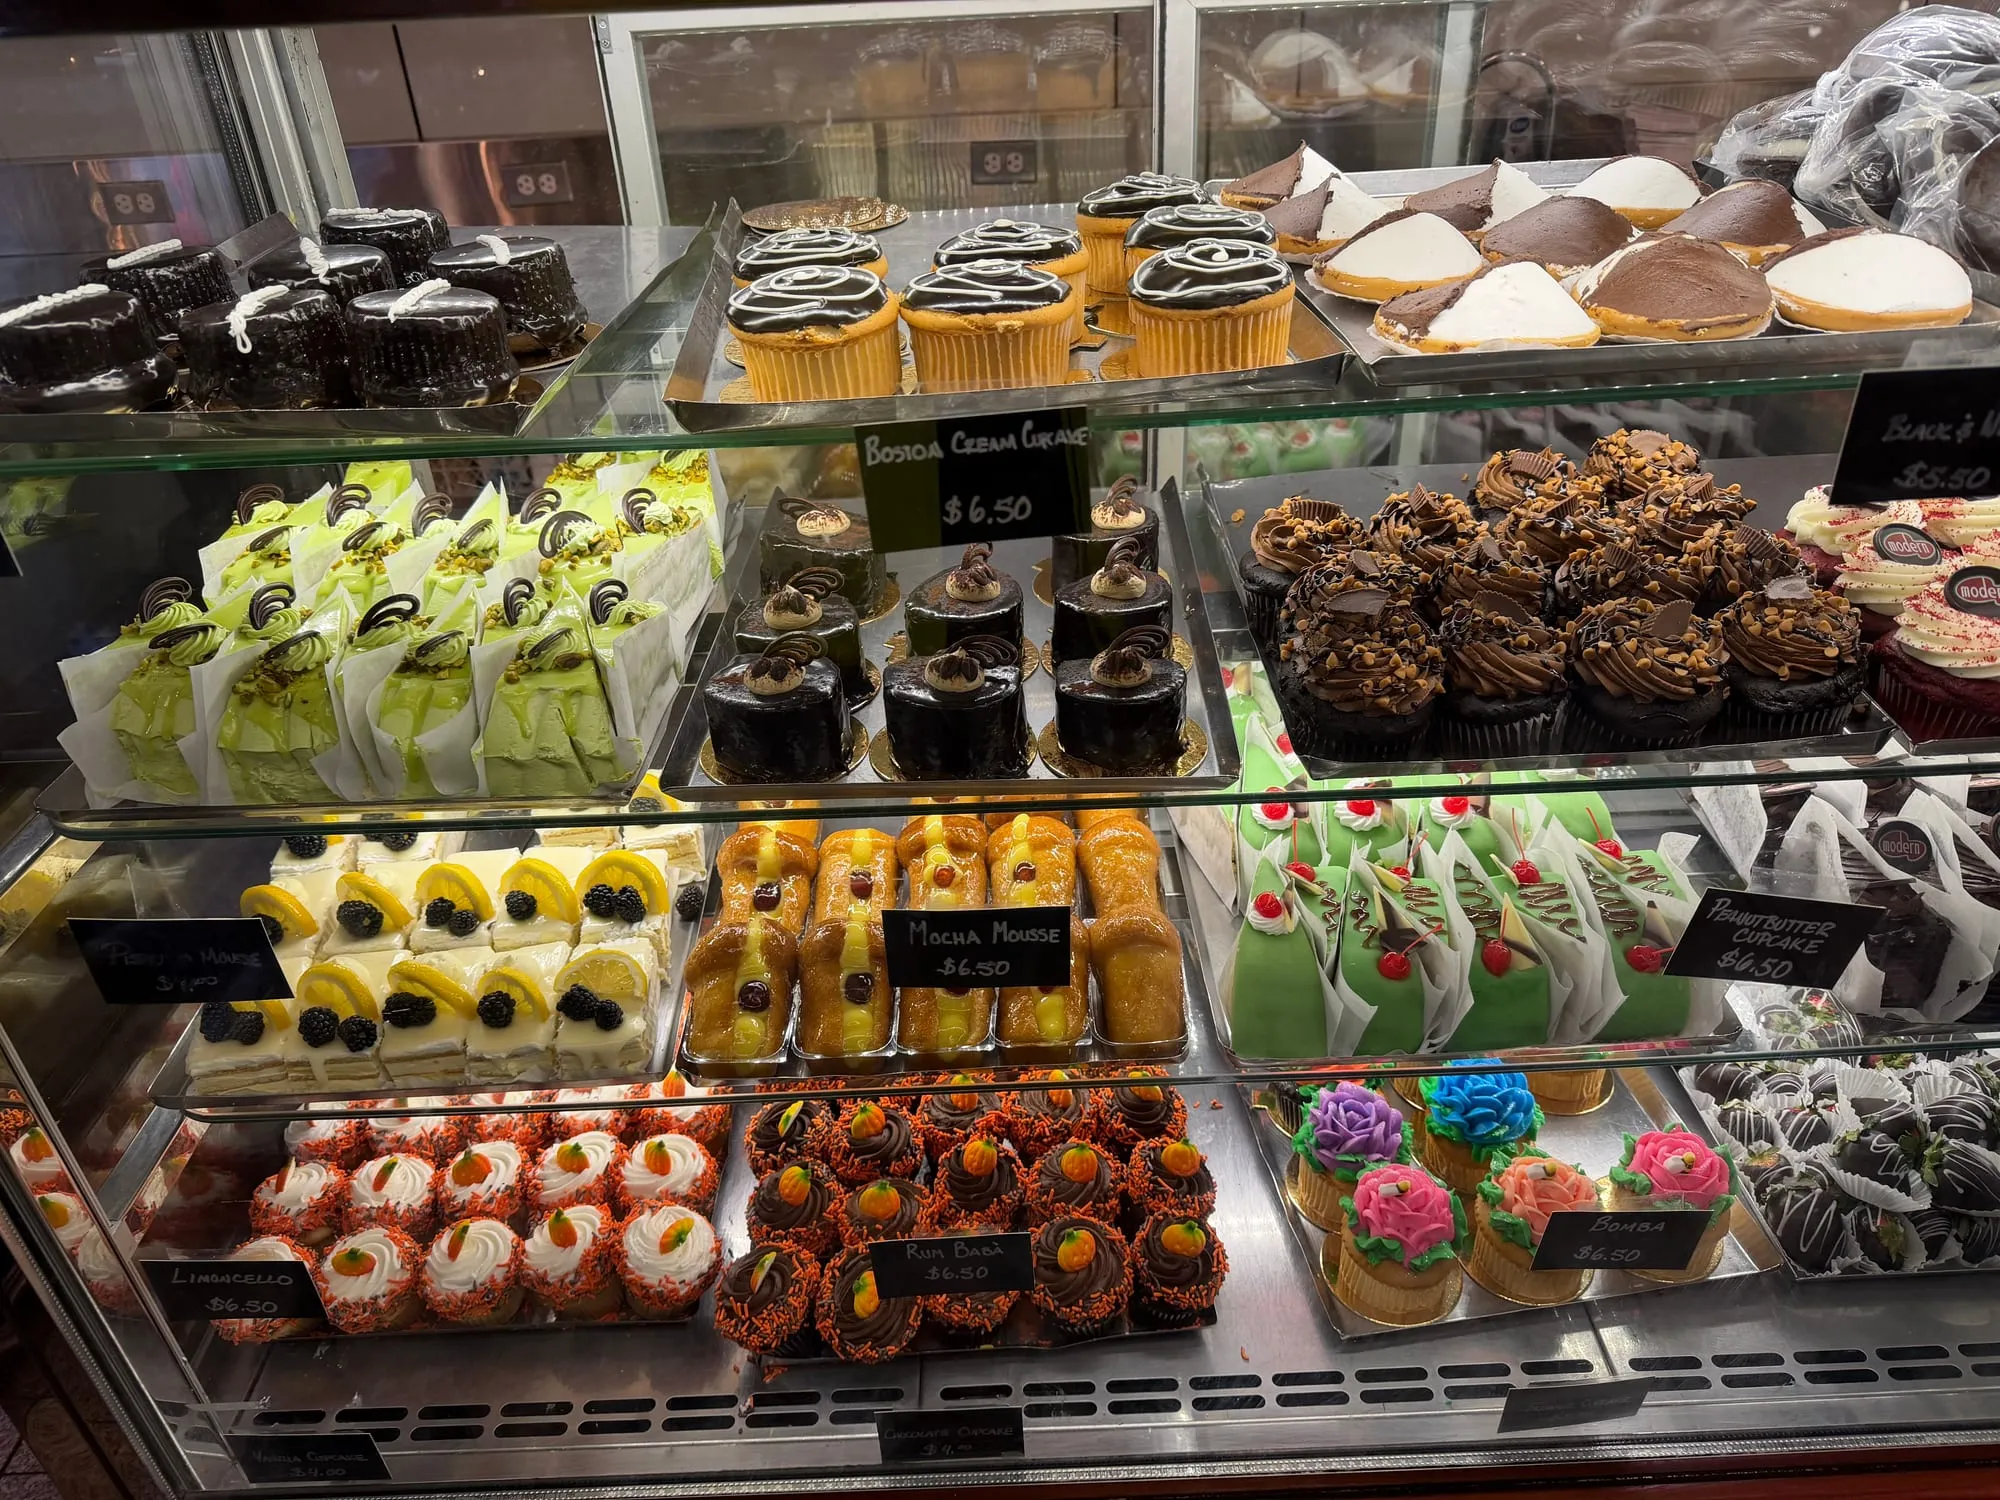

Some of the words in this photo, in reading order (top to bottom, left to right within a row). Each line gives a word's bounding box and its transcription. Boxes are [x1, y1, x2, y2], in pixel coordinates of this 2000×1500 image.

[1881, 413, 1953, 443] BLACK
[863, 434, 944, 467] BOSTON
[951, 430, 1017, 455] CREAM
[1893, 460, 1991, 490] $5.50
[1887, 532, 1930, 554] modern
[1882, 830, 1921, 856] modern
[909, 919, 982, 947] MOCHA
[992, 920, 1061, 945] MOUSSE
[1732, 927, 1825, 955] CUPCAKE
[936, 957, 1011, 977] $6.50
[1717, 947, 1794, 980] $6.50
[1589, 1215, 1666, 1233] BOMBA
[906, 1243, 945, 1260] RUM
[1573, 1245, 1641, 1262] $6.50
[170, 1267, 295, 1286] LIMONCELLO
[925, 1265, 989, 1281] $6.50
[205, 1297, 278, 1313] $6.50
